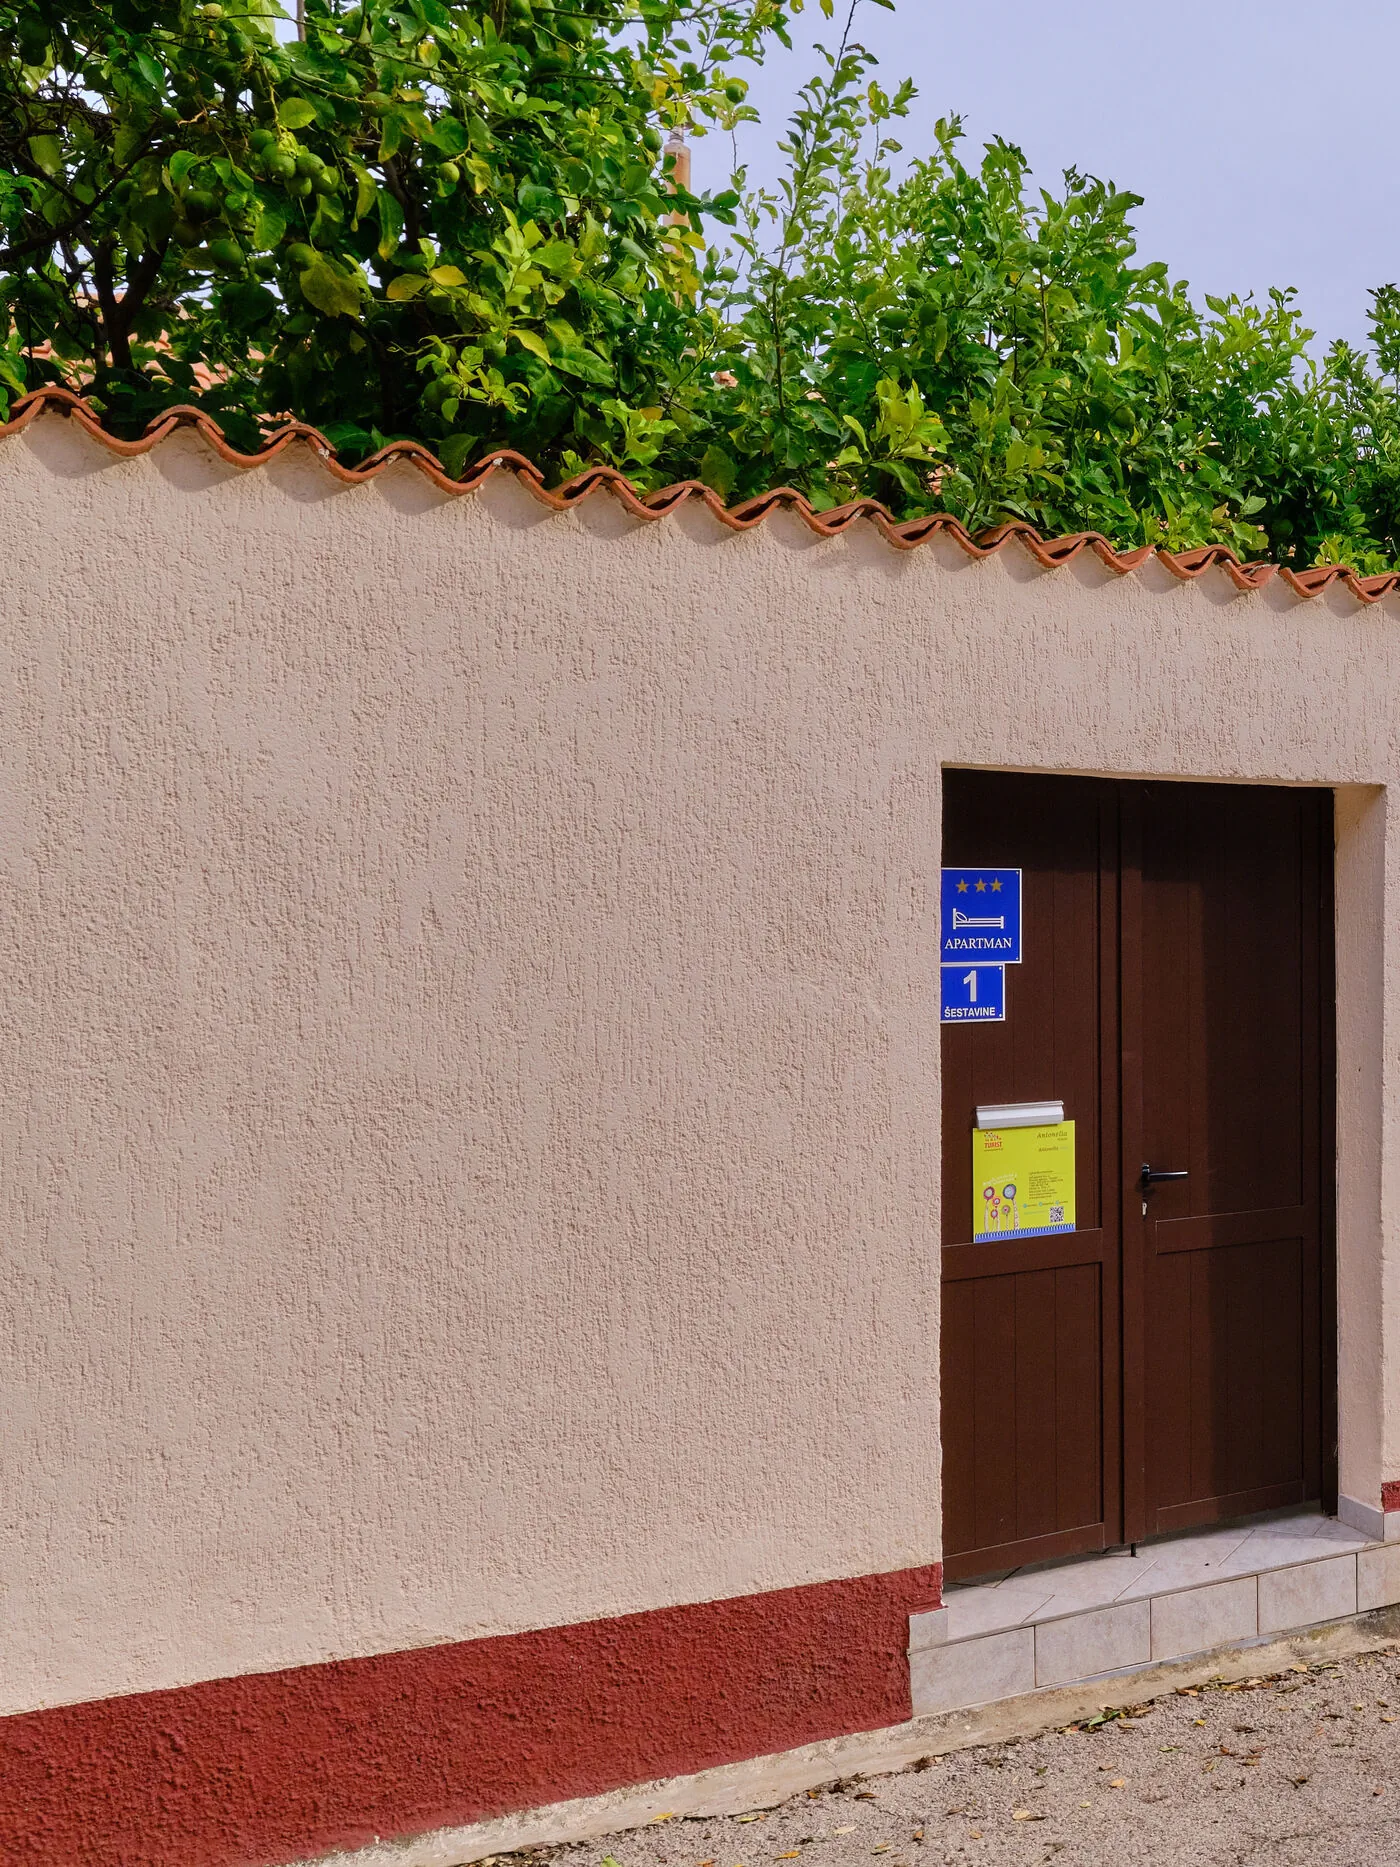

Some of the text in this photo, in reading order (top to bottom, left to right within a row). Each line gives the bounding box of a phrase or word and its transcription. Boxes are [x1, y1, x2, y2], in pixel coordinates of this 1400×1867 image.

[944, 937, 1012, 949] APARTMAN
[963, 970, 977, 1002] 1
[944, 1006, 995, 1018] ŠESTAVINE
